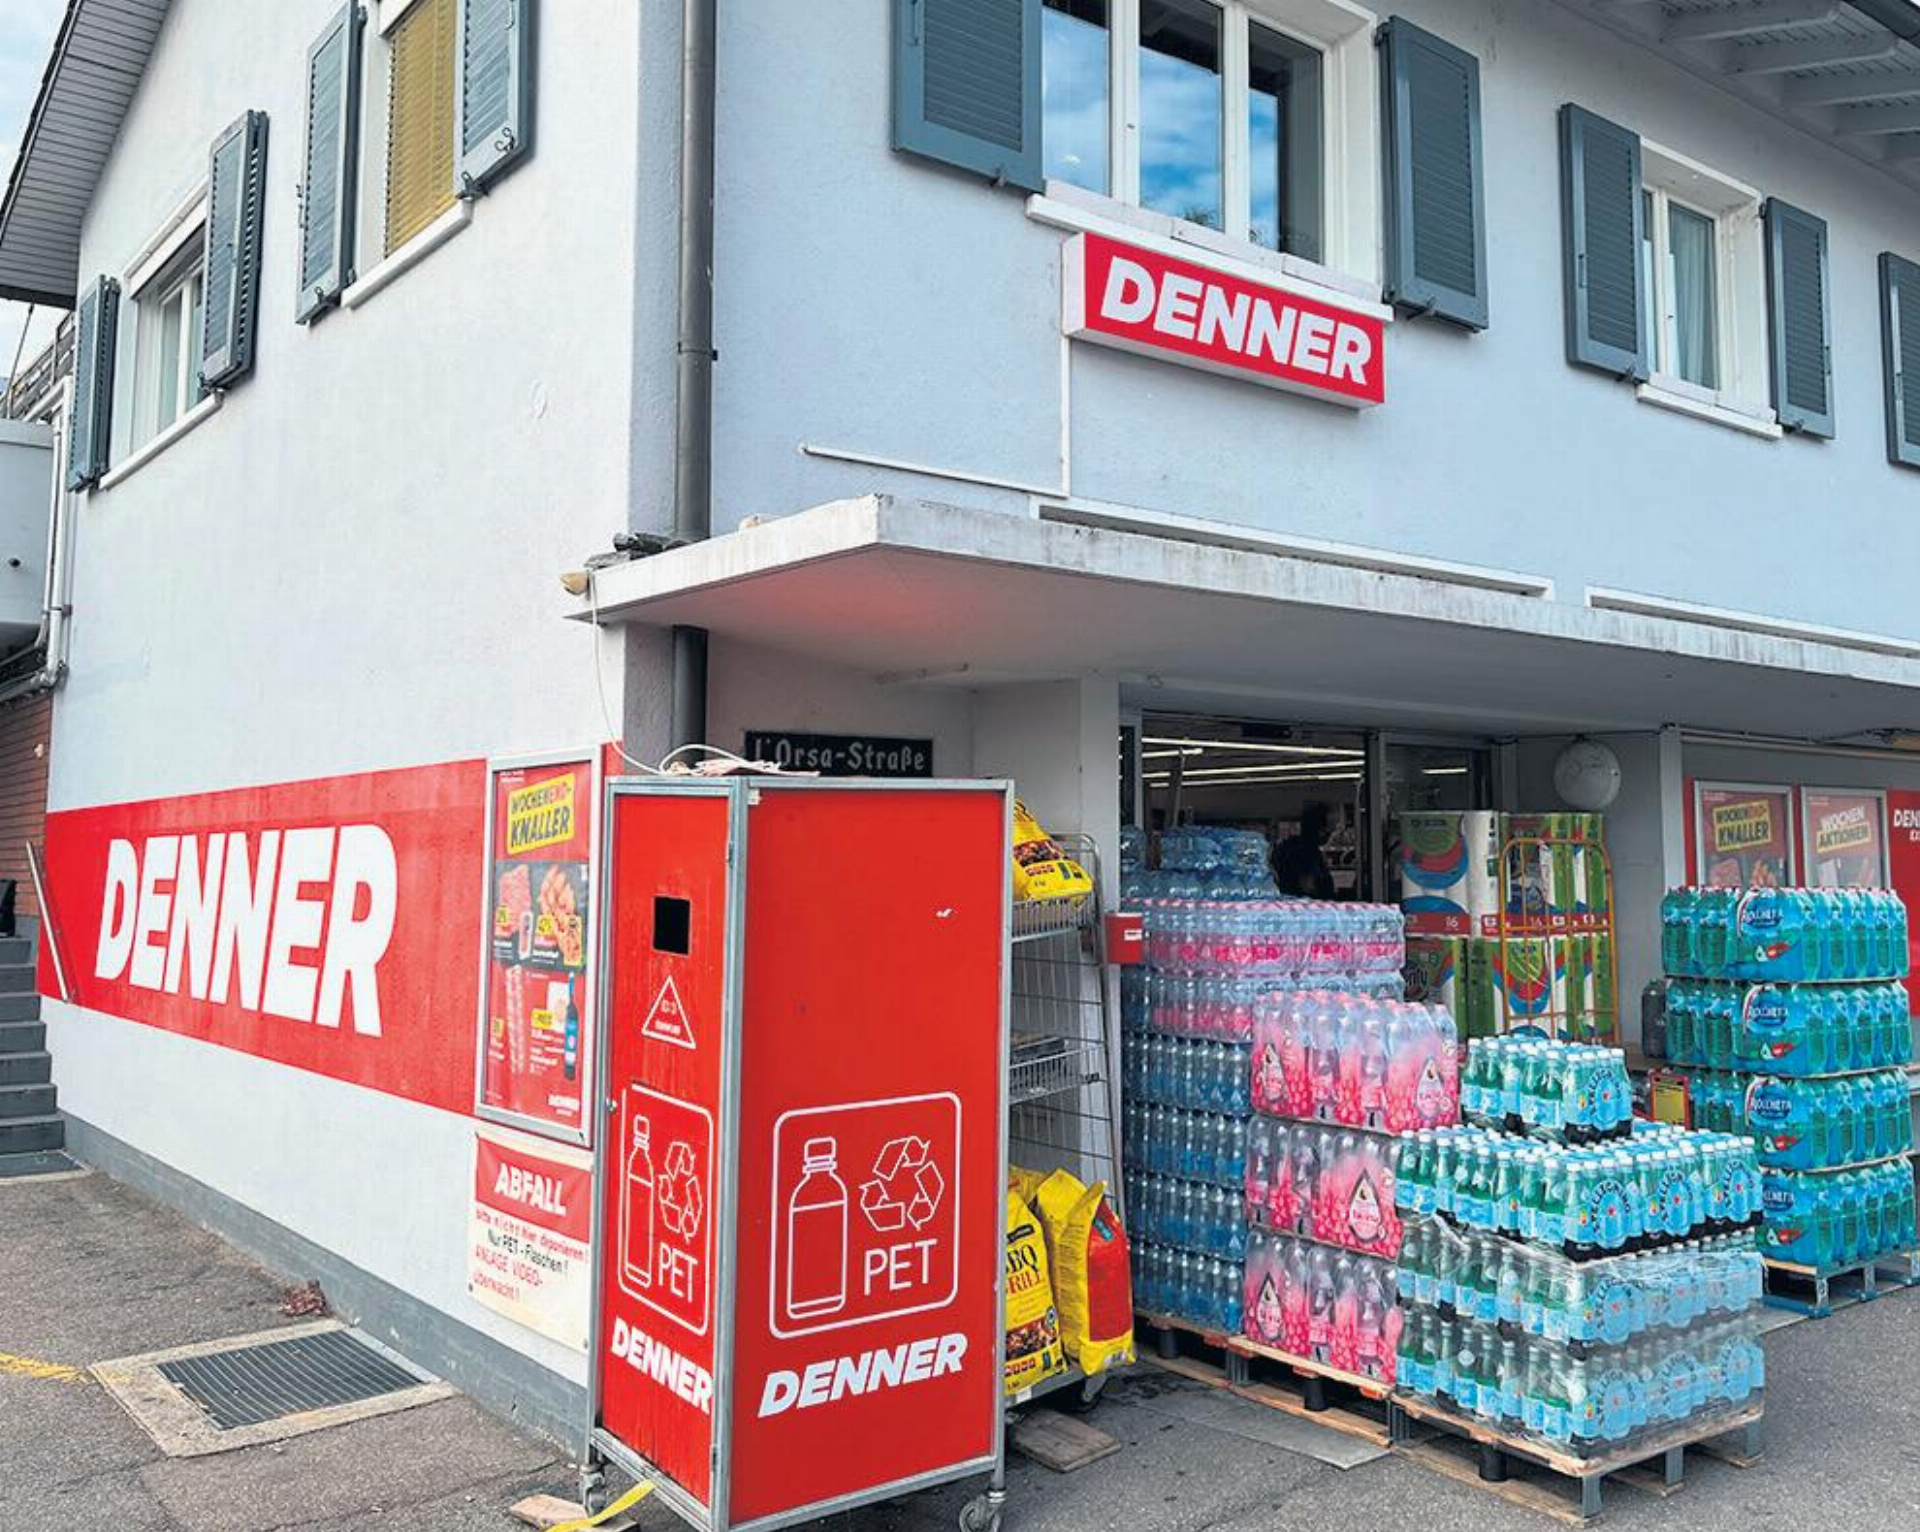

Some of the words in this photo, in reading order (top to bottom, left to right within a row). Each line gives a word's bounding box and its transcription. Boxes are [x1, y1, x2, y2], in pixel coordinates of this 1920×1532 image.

[1100, 255, 1371, 385] DENNER
[511, 806, 570, 848] KNALLER
[1717, 821, 1769, 848] KNALLER
[1820, 805, 1865, 832] WOCHEN
[94, 823, 398, 1038] DENNER
[494, 1162, 567, 1217] ABFALL
[658, 1242, 698, 1303] PET
[864, 1238, 937, 1296] PET
[1006, 1244, 1040, 1273] BQ
[610, 1317, 713, 1414] DENNER
[758, 1332, 968, 1418] DENNER
